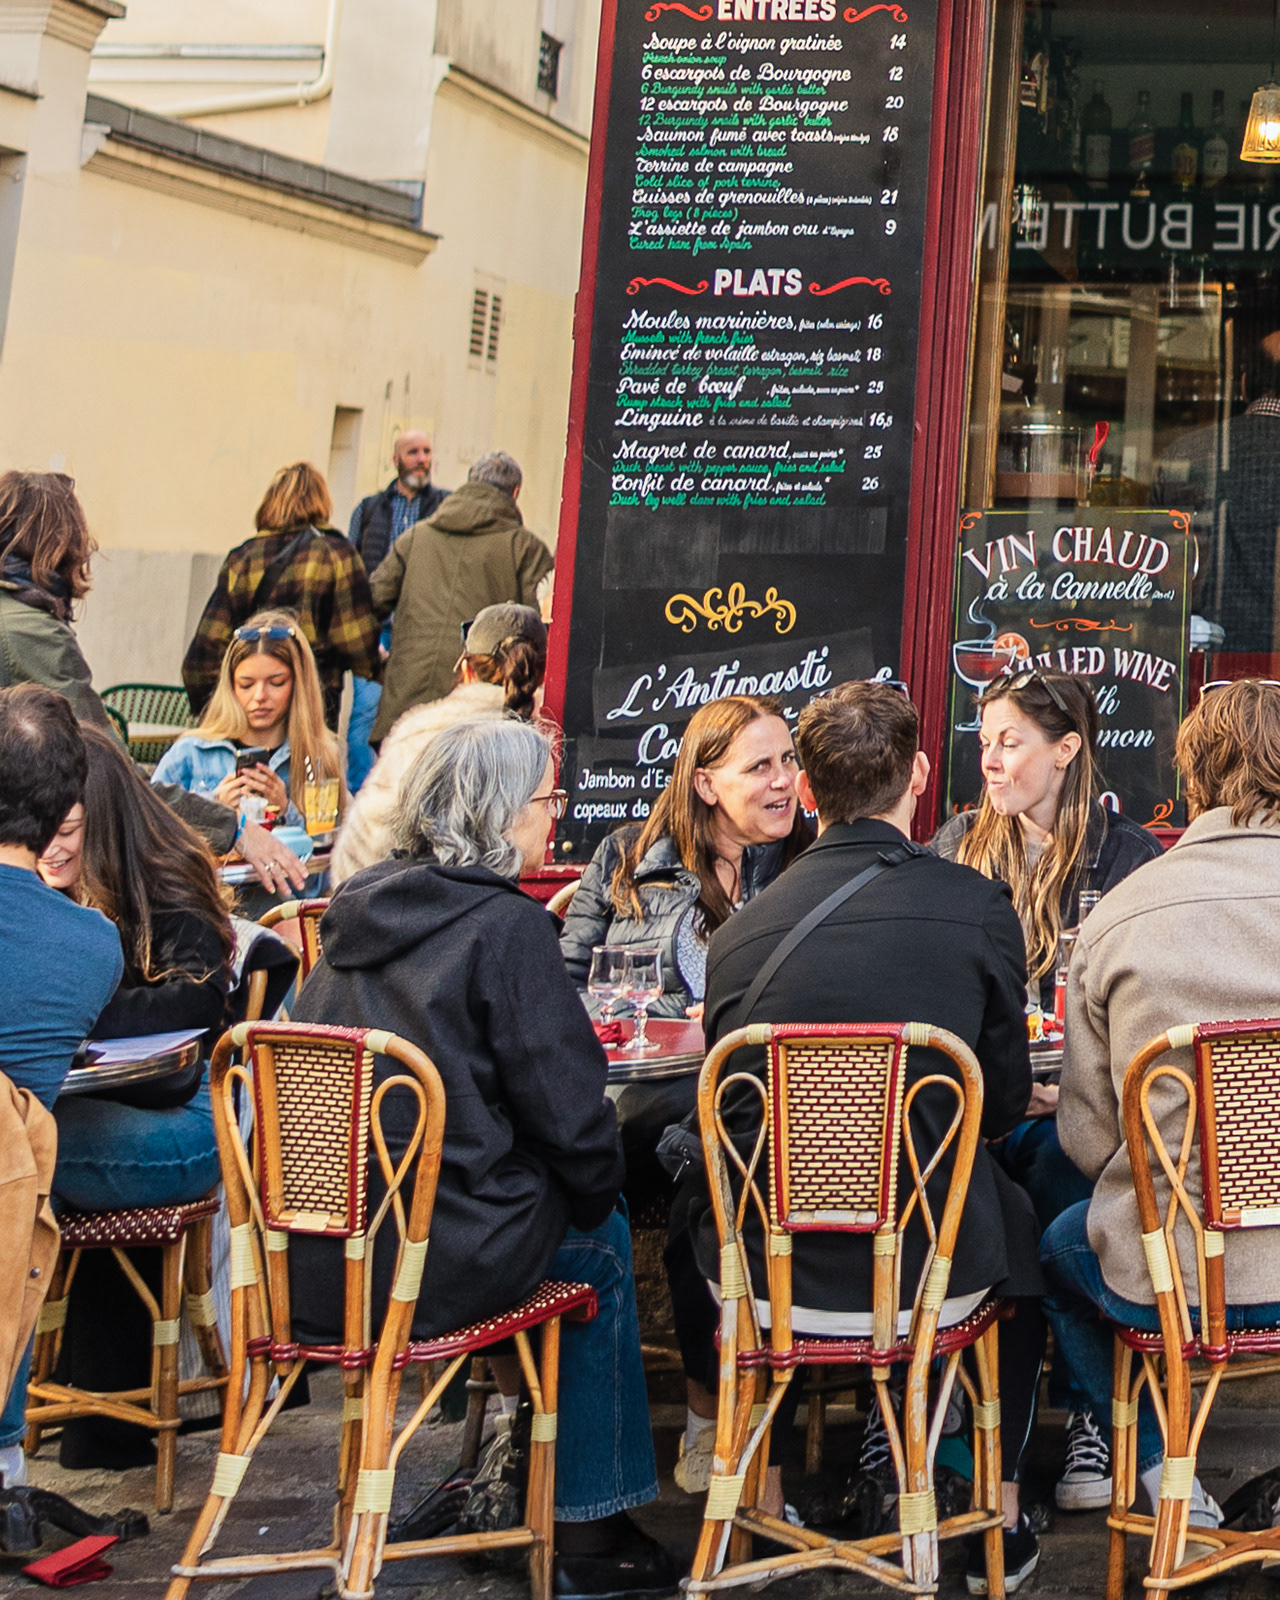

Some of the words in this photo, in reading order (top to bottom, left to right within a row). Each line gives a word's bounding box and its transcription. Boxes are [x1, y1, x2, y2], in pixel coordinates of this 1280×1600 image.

[643, 32, 697, 57] Soupe
[701, 33, 712, 50] à
[715, 32, 776, 55] l'oignon
[781, 35, 843, 56] gratinée
[890, 34, 906, 50] 14
[642, 65, 652, 79] 6
[654, 65, 725, 85] escargots
[730, 65, 751, 80] de
[757, 63, 851, 86] Bourgogne
[889, 67, 903, 81] 12
[640, 97, 655, 111] 12
[658, 97, 728, 116] escargots
[733, 95, 752, 111] de
[759, 97, 848, 118] Bourgogne
[885, 96, 904, 109] 20
[637, 126, 704, 143] Saumon
[710, 127, 747, 147] fumé
[752, 129, 786, 142] avec
[791, 128, 833, 142] toasts
[882, 126, 898, 142] 18
[636, 157, 689, 173] Terrine
[695, 157, 713, 172] de
[718, 160, 793, 177] campagne
[632, 189, 690, 204] Cuisses
[695, 189, 715, 204] de
[720, 188, 805, 207] grenouilles
[881, 189, 898, 204] 21
[628, 220, 707, 236] L'assiette
[711, 220, 731, 235] de
[735, 220, 788, 240] jambon
[793, 224, 819, 235] cru
[885, 219, 897, 235] 9
[713, 268, 802, 296] PLATS
[622, 309, 690, 330] Moules
[696, 310, 797, 330] marinières,
[868, 314, 883, 329] 16
[616, 377, 660, 395] Pavé
[666, 378, 686, 393] de
[868, 381, 883, 394] 25
[614, 409, 703, 431] Linguine
[612, 440, 688, 465] Magret
[693, 440, 716, 459] de
[864, 446, 882, 459] 25
[611, 473, 665, 496] Confit
[671, 475, 694, 490] de
[862, 478, 879, 490] 26
[963, 530, 1037, 579] VIN
[1052, 527, 1169, 574] CHAUD
[986, 574, 1007, 600] à
[1016, 572, 1045, 599] la
[1051, 572, 1153, 600] Cannelle
[1000, 647, 1105, 675] LED
[1114, 648, 1176, 692] WINE
[579, 769, 634, 790] Jambon
[574, 801, 626, 824] copeaux
[633, 800, 649, 817] de
